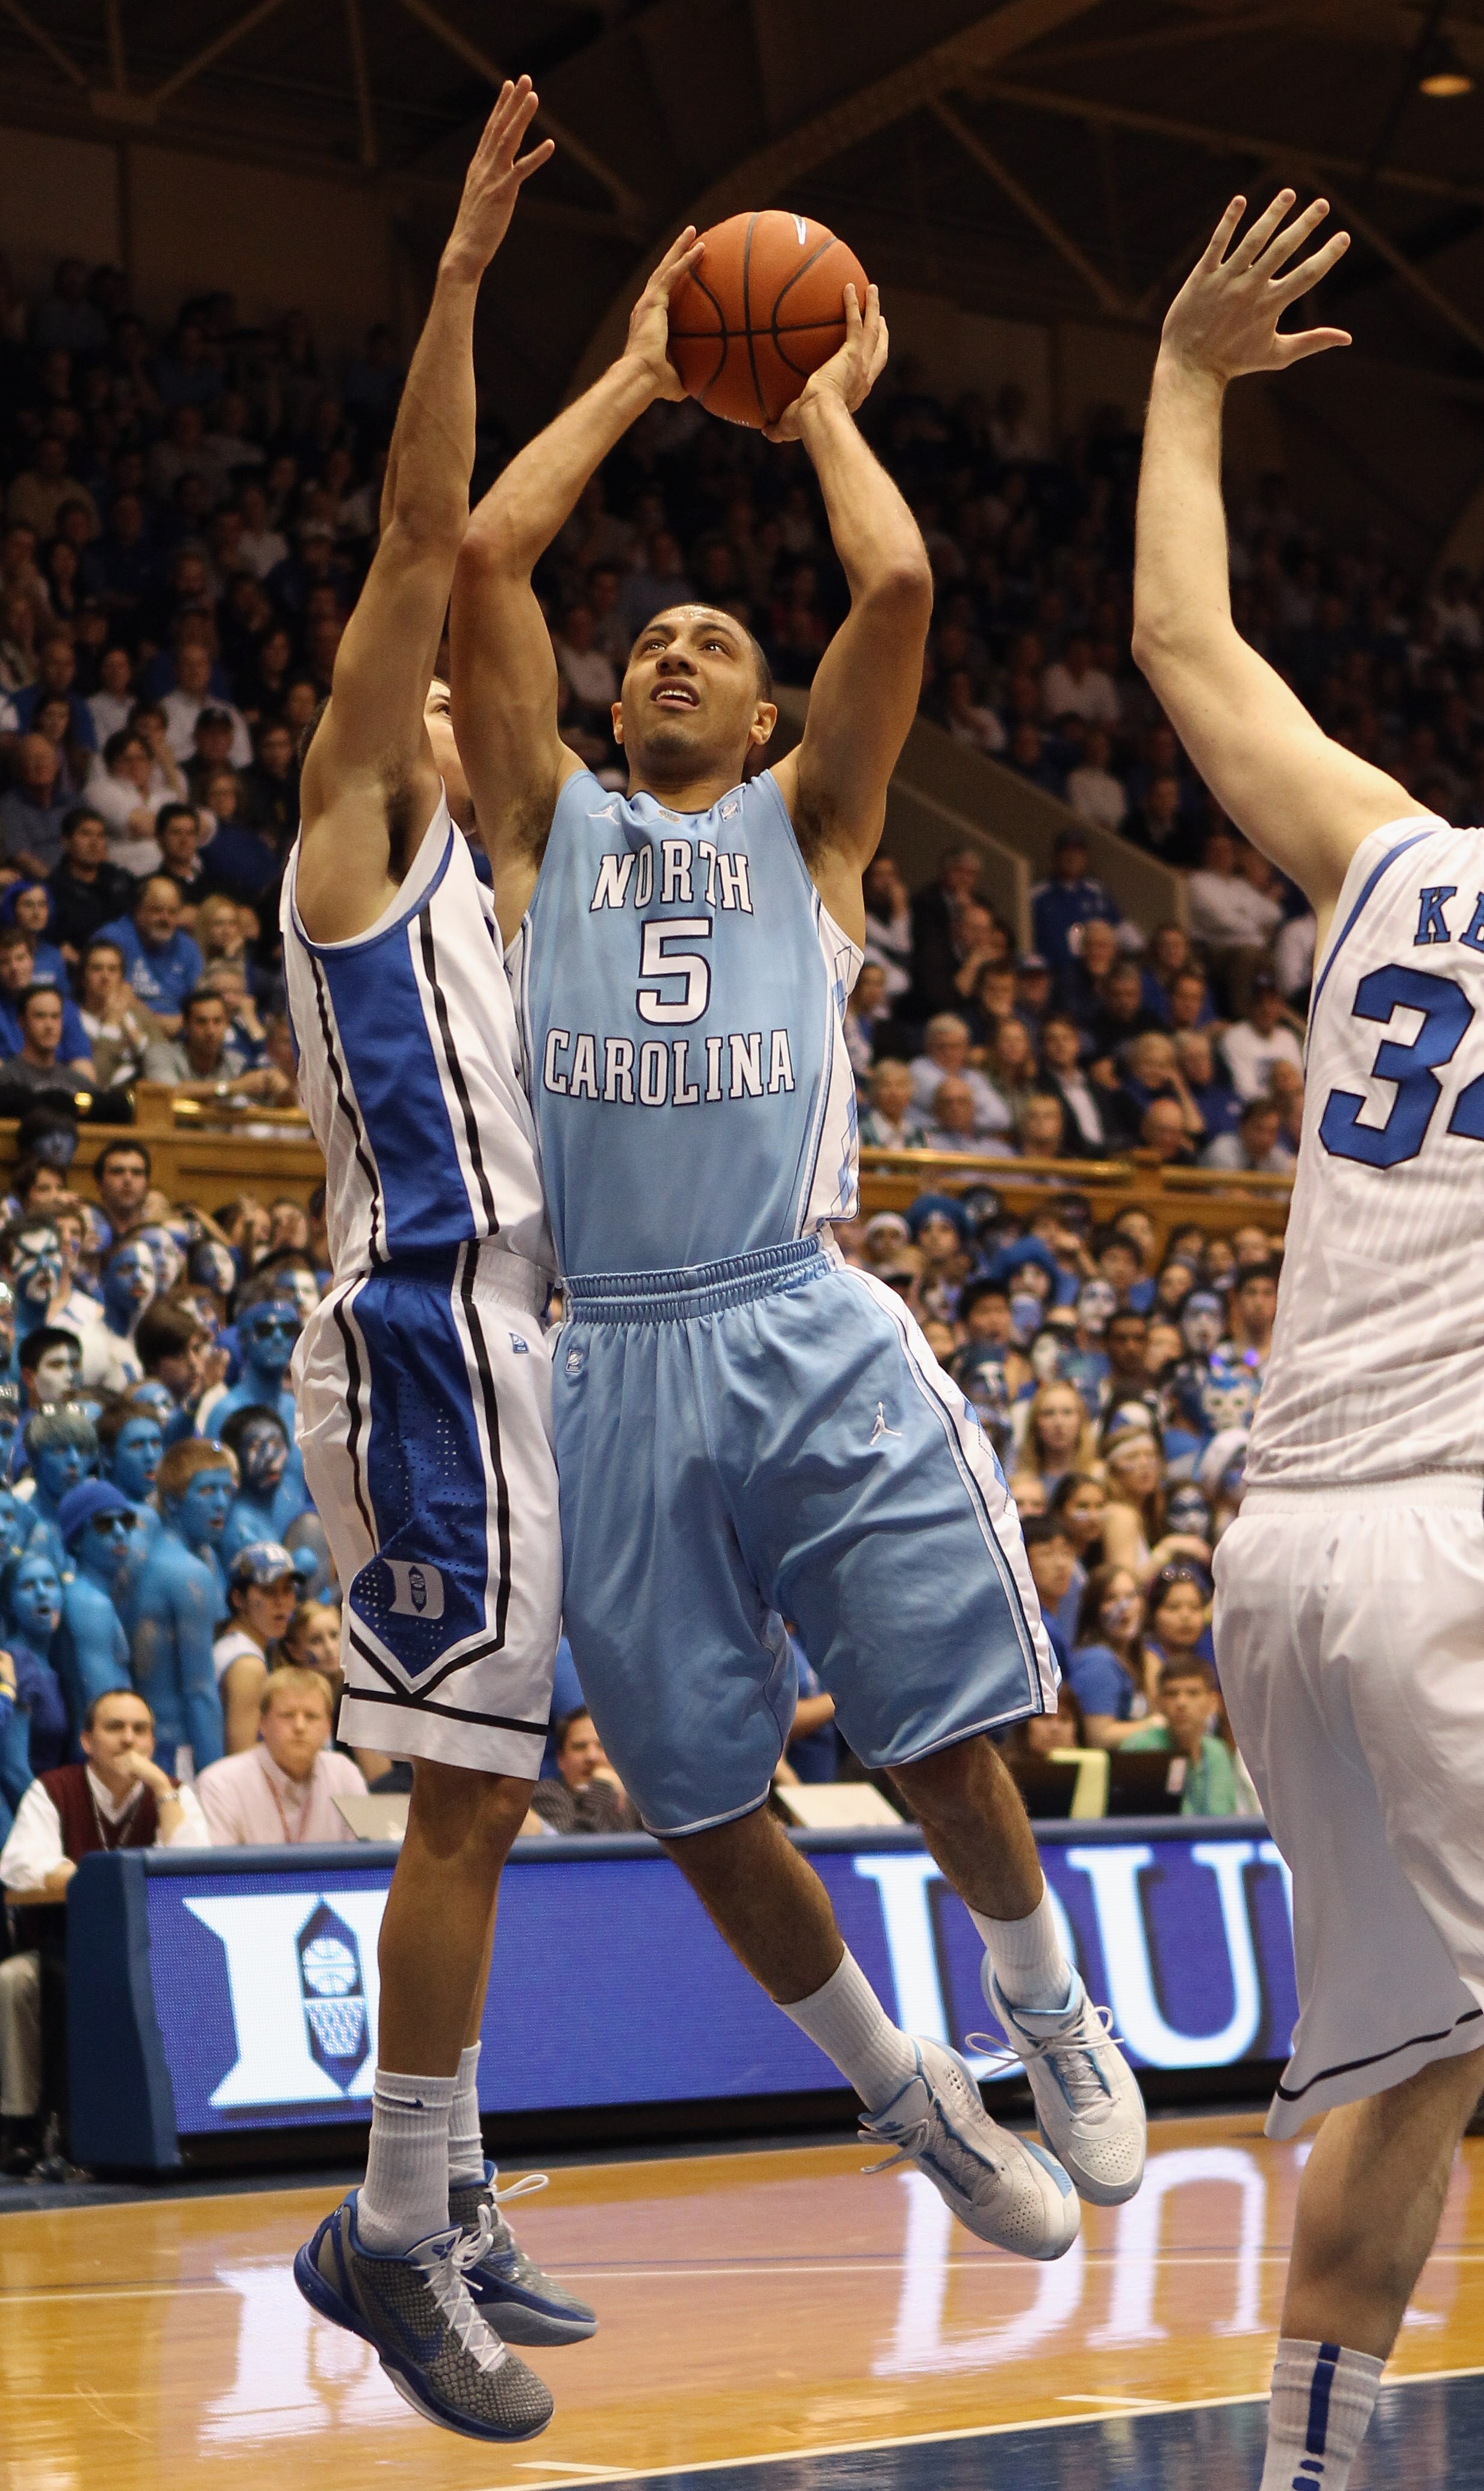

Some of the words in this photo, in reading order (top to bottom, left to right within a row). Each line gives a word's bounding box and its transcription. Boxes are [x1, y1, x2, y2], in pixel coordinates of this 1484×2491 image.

[589, 839, 754, 915] NORTH
[636, 917, 713, 1026] 5
[543, 1028, 796, 1107] CAROLINA
[1318, 963, 1484, 1170] 3
[853, 1842, 1295, 2083] DU
